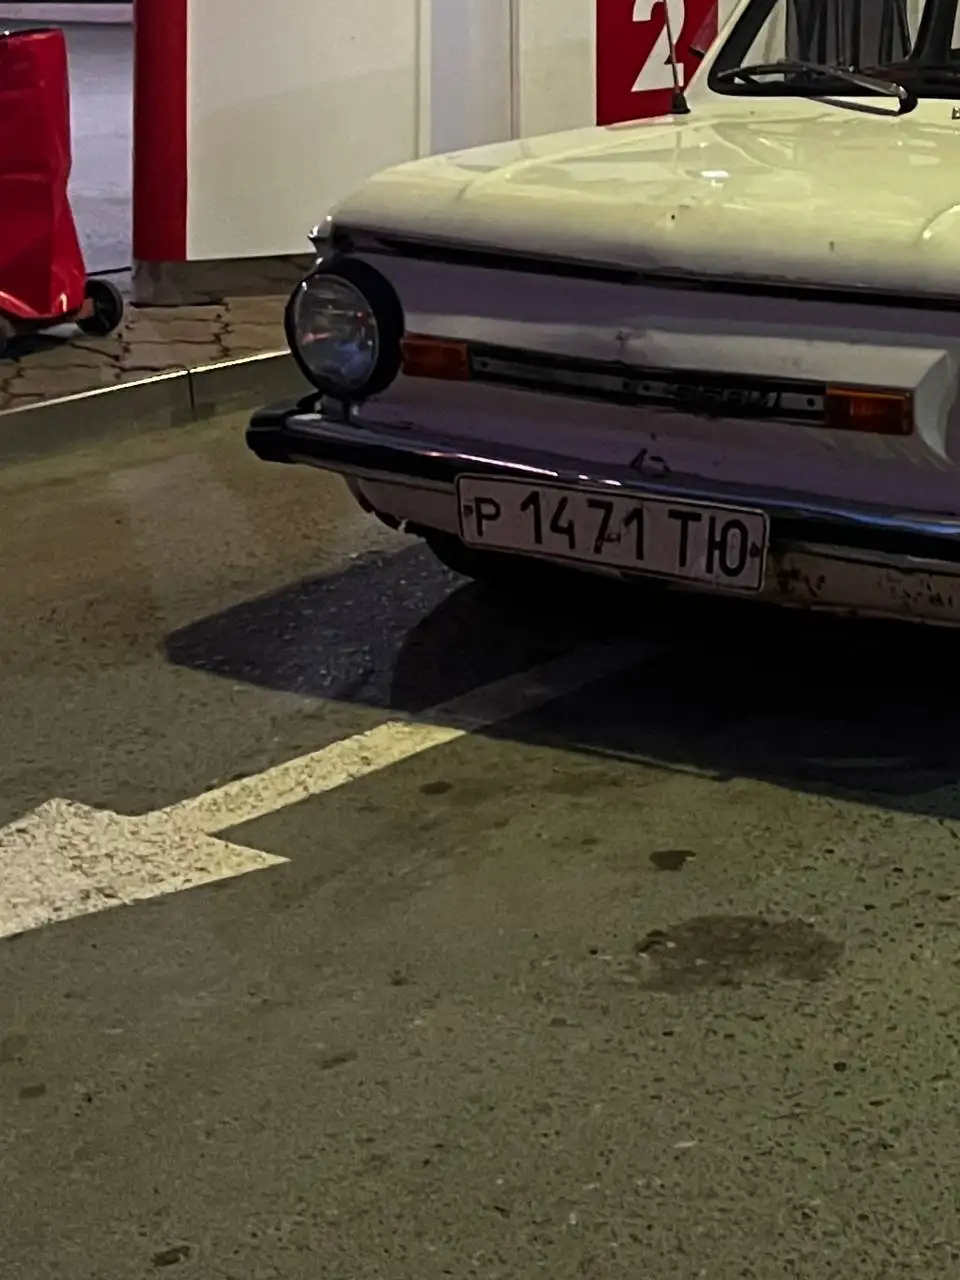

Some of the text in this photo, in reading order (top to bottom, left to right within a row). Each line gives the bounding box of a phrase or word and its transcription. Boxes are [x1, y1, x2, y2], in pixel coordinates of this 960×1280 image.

[474, 490, 749, 577] Р 1471 ТЮ
